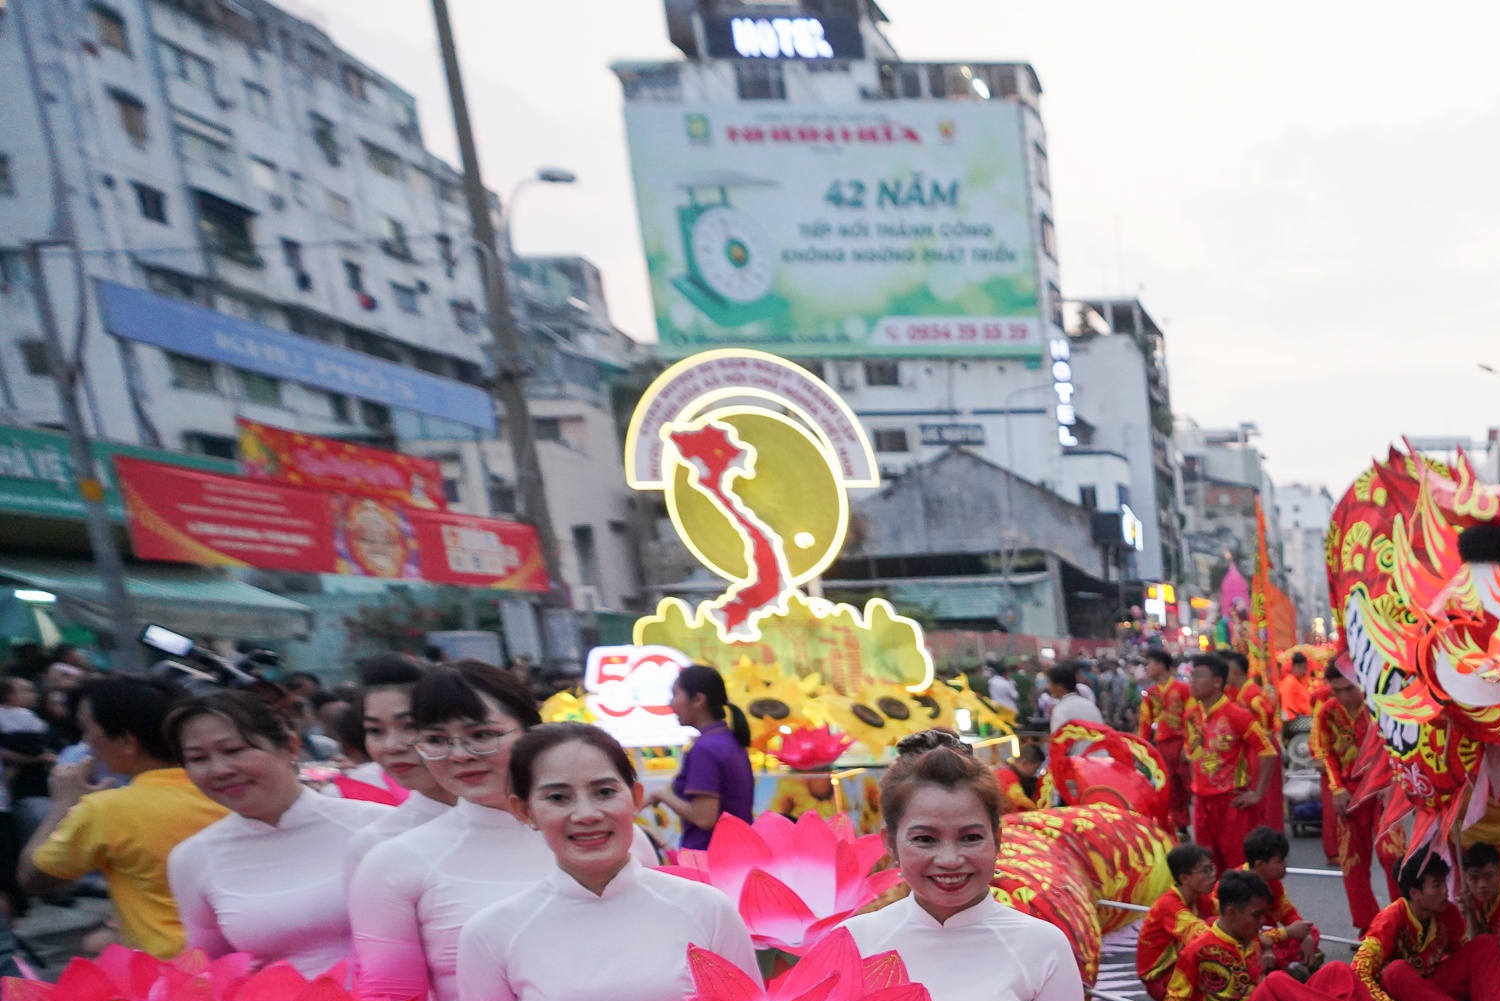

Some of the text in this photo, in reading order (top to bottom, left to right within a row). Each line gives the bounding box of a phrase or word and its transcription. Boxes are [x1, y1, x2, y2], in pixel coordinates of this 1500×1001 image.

[823, 172, 960, 209] 42 NĂM
[1050, 339, 1079, 447] HOTEL
